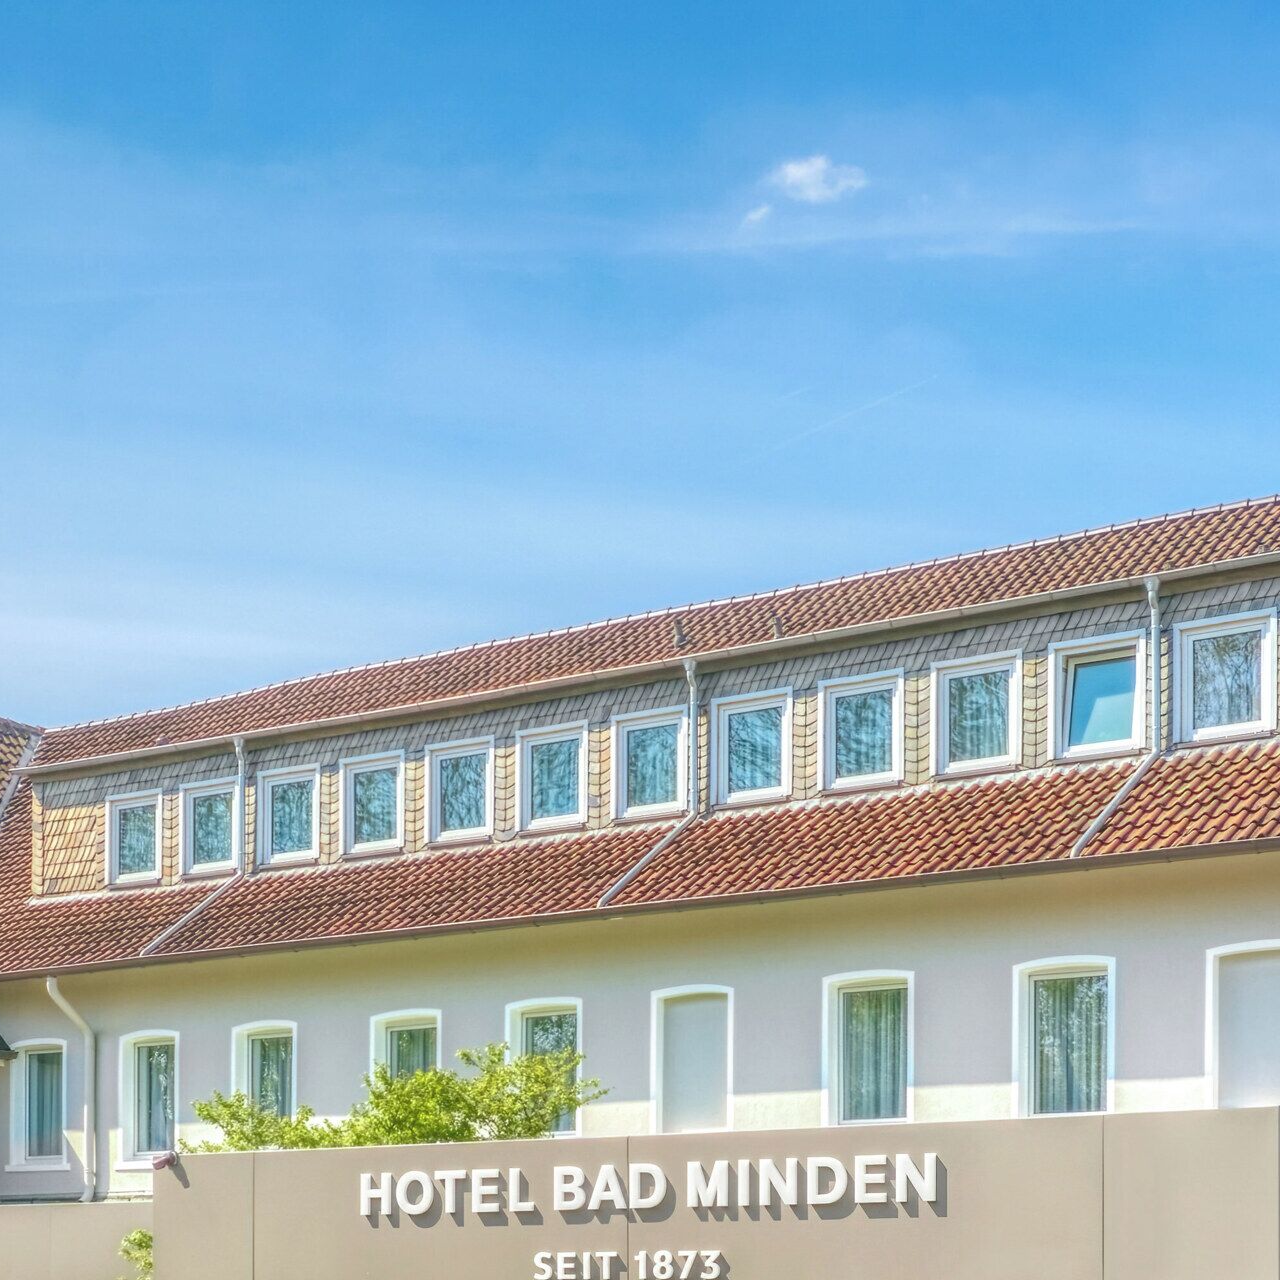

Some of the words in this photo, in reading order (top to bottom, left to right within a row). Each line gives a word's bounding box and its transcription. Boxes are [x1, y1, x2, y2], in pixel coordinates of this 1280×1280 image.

[360, 1167, 535, 1216] HOTEL
[553, 1163, 667, 1211] BAD
[686, 1152, 938, 1208] MINDEN
[533, 1251, 618, 1280] SEIT
[634, 1249, 721, 1280] 1873
